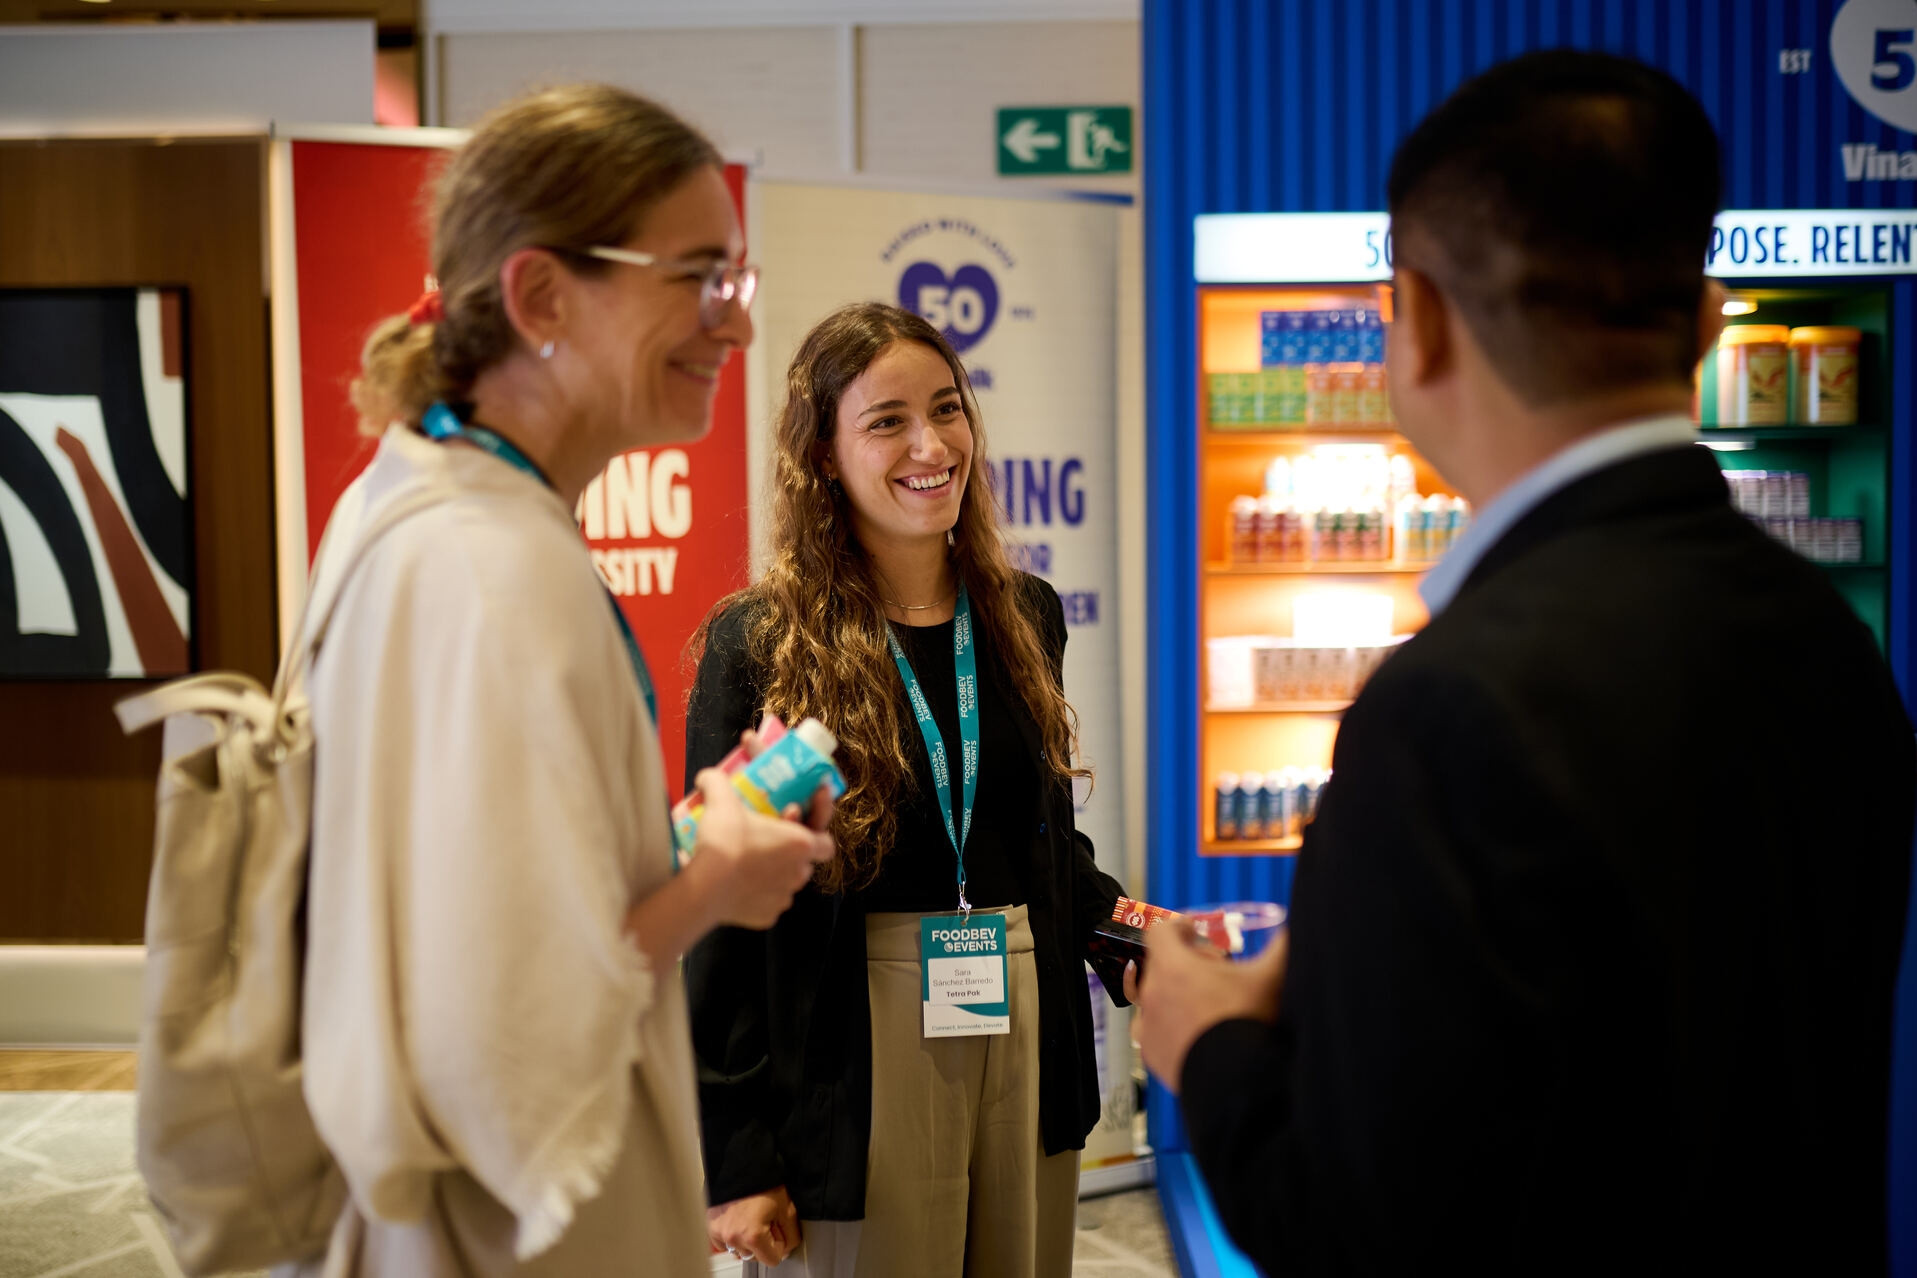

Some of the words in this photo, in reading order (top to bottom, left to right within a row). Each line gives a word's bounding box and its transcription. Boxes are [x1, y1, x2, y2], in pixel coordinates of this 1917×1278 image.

[1779, 50, 1811, 73] EST
[918, 286, 984, 334] 50
[575, 448, 692, 540] ING
[986, 458, 1084, 526] ING
[955, 616, 963, 655] FOODBEV
[910, 679, 931, 720] FOODBEV
[911, 691, 925, 722] EVENTS
[958, 676, 968, 718] FOODBEV
[932, 757, 943, 788] EVENTS
[935, 741, 948, 786] FOODBEV
[963, 740, 971, 784] FOODBEV
[931, 928, 997, 942] FOODBEV
[953, 941, 998, 952] EVENTS
